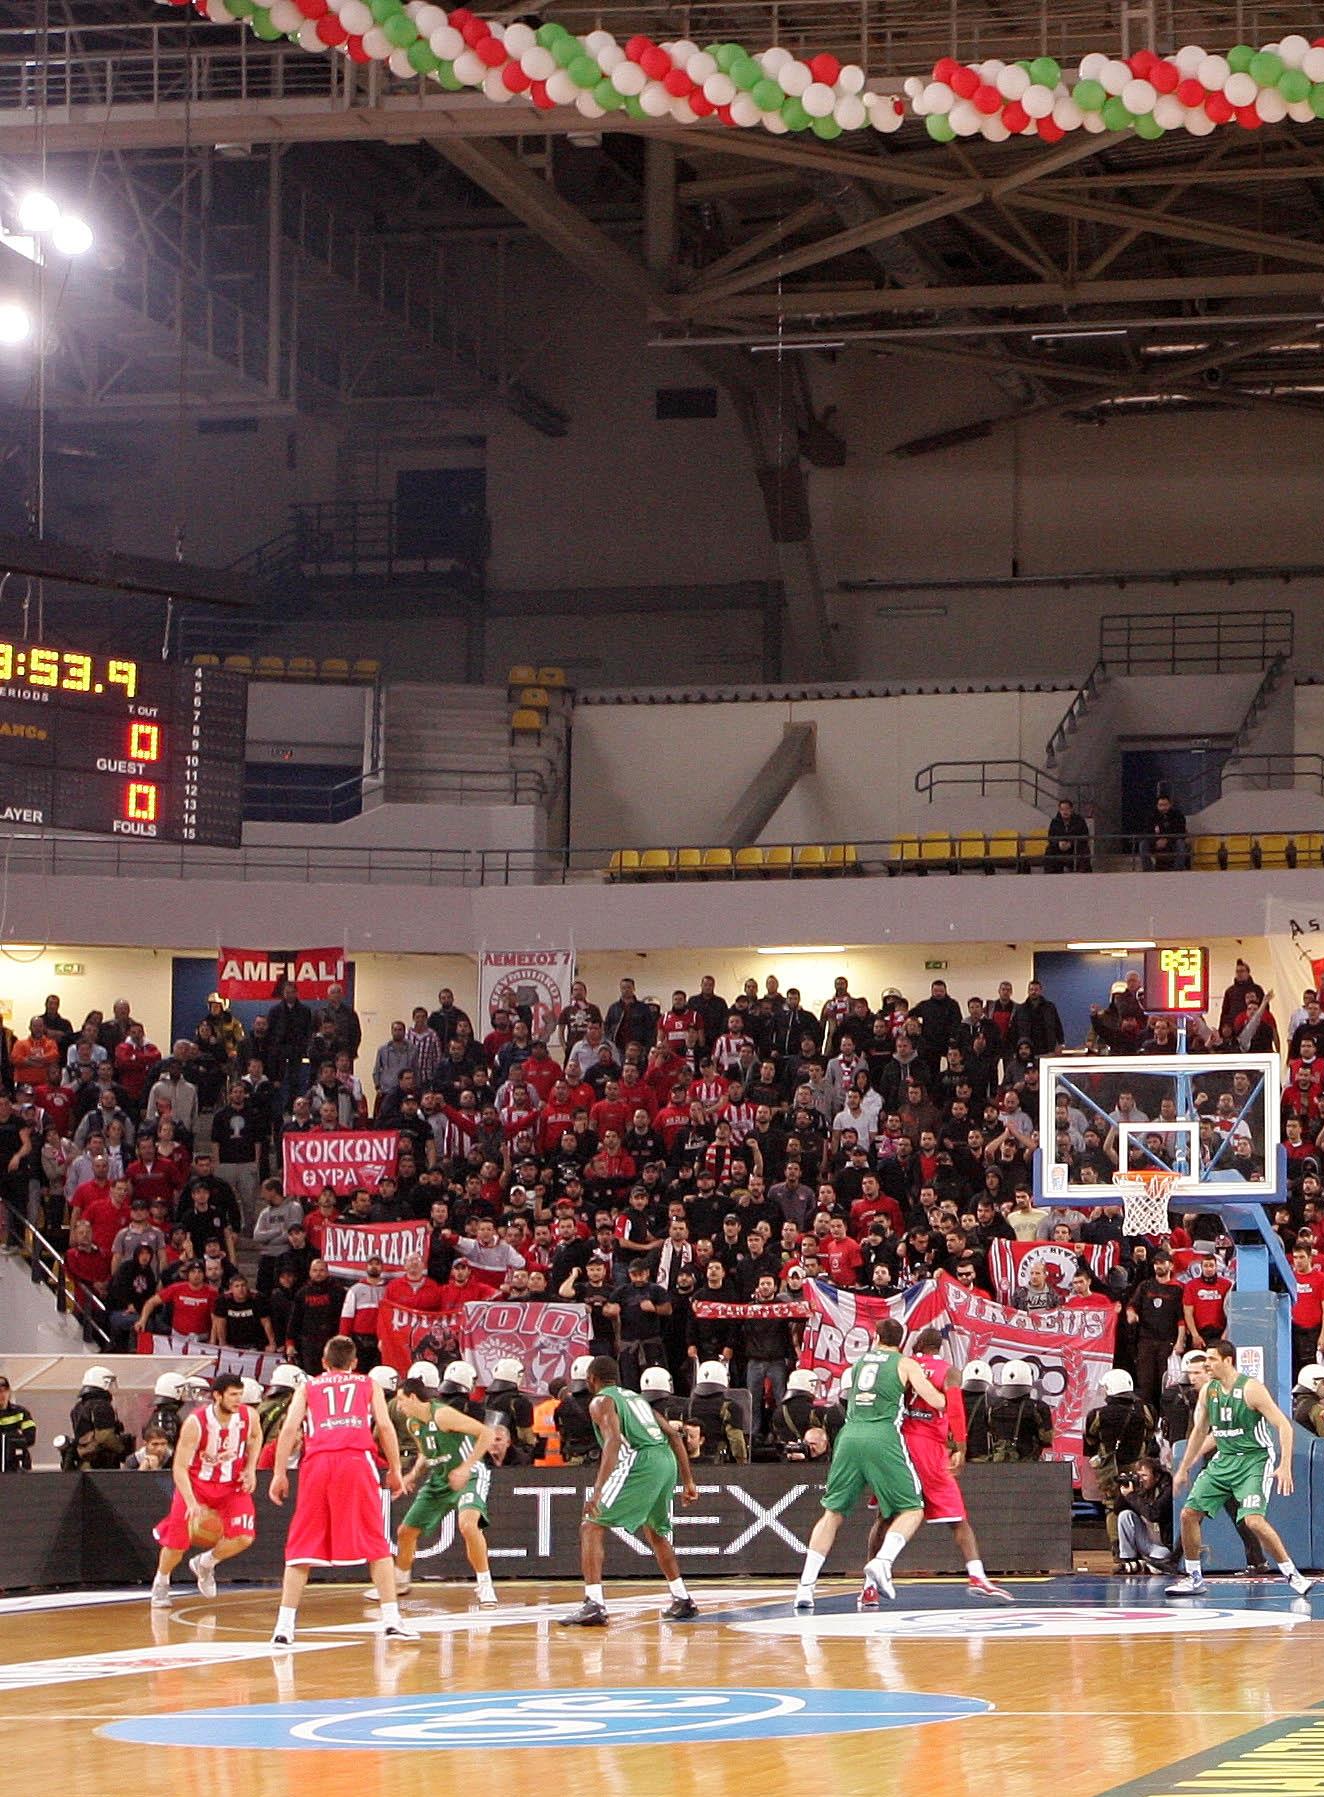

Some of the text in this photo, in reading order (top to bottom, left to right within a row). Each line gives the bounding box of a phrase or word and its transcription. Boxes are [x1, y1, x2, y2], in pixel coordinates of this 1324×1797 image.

[194, 667, 202, 678] 4
[194, 681, 202, 692] 5
[0, 687, 49, 702] ERIODS
[193, 696, 201, 708] 6
[138, 706, 159, 717] OUT
[193, 710, 200, 721] 7
[192, 724, 200, 737] 8
[130, 723, 158, 760] 0
[191, 739, 200, 751] 9
[97, 757, 146, 775] GUEST
[185, 755, 199, 767] 10
[185, 770, 198, 782] 11
[184, 784, 198, 797] 12
[128, 782, 156, 819] 0
[183, 799, 197, 811] 13
[183, 813, 196, 825] 14
[113, 820, 157, 836] FOULS
[182, 828, 196, 840] 15
[221, 960, 345, 982] AMFIALI
[1168, 970, 1201, 1008] 12
[290, 1137, 396, 1164] ΚΟΚΚΩΝΙ
[302, 1168, 358, 1186] ΘΥΡΑ
[944, 1282, 1106, 1339] PIRAEUS
[858, 1362, 880, 1391] 6
[322, 1383, 356, 1416] 17
[242, 1514, 255, 1530] 16
[378, 1485, 808, 1559] ULTEX
